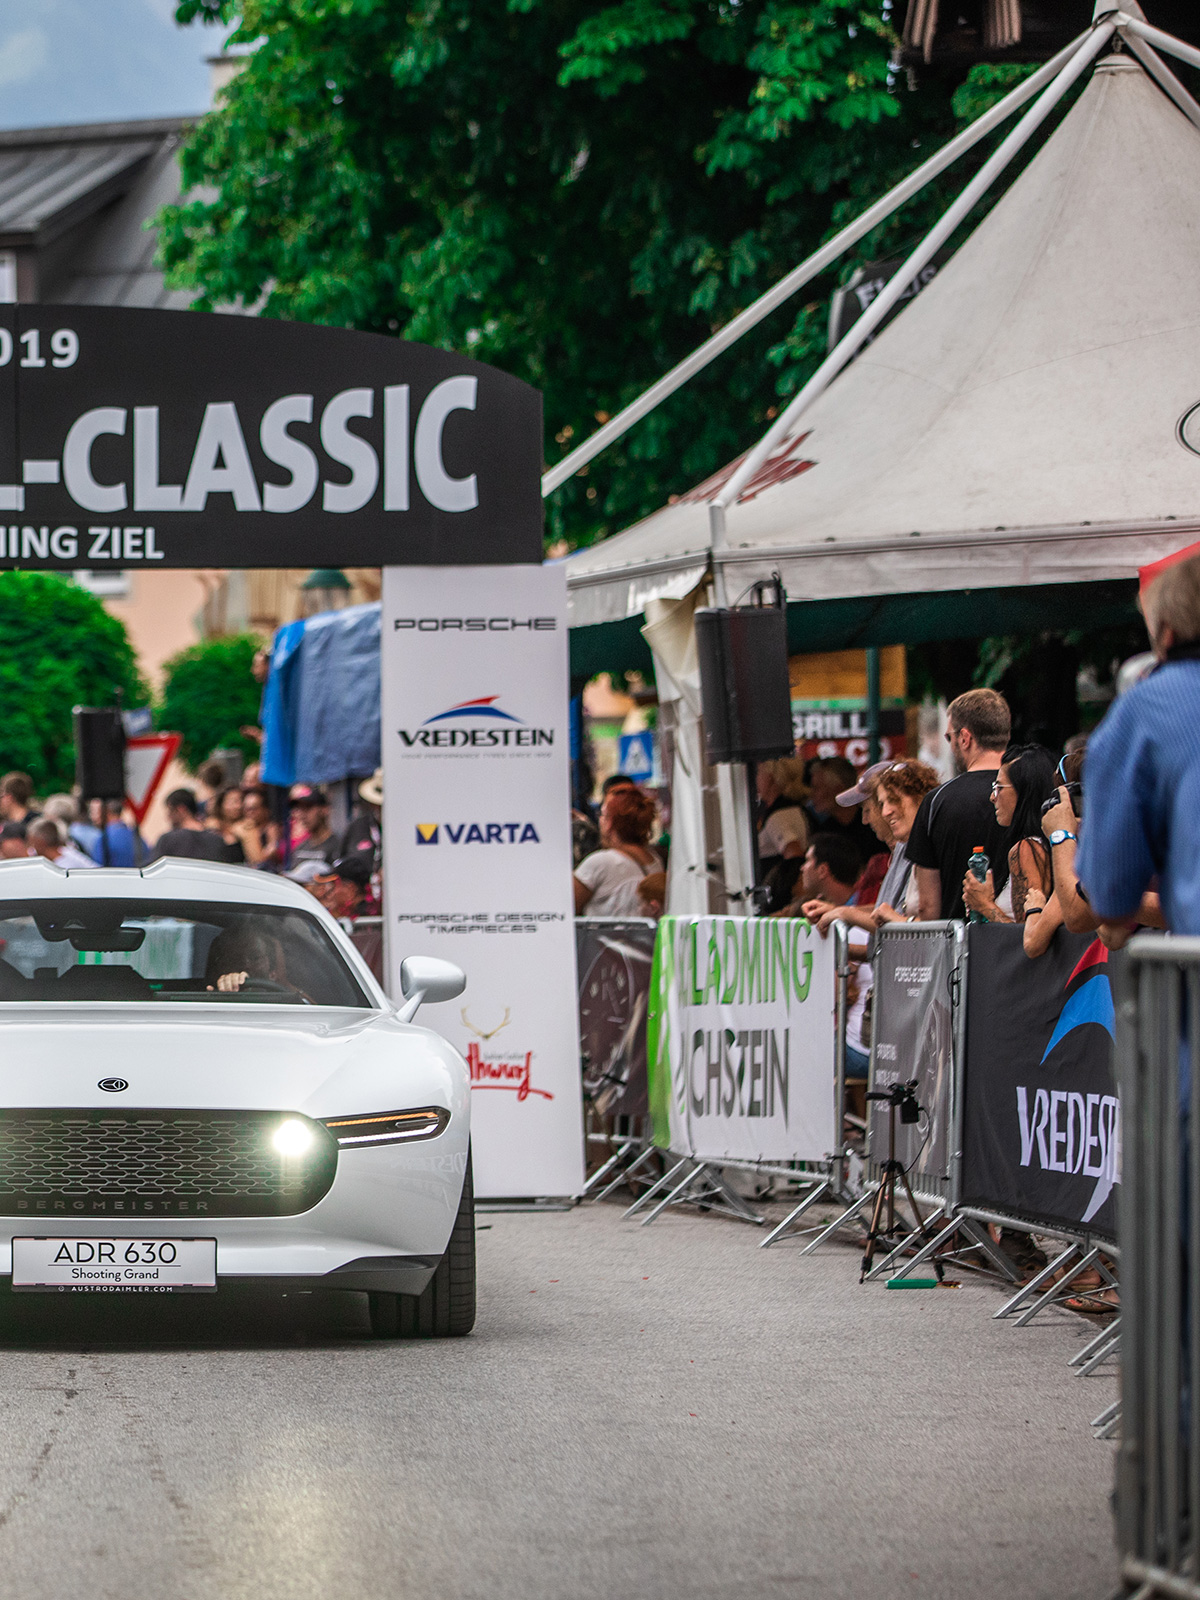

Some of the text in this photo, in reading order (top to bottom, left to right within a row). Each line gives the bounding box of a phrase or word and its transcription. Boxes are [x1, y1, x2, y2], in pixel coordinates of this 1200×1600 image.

[87, 526, 164, 560] ZIEL
[393, 617, 557, 632] PORSCHE
[397, 728, 555, 747] VREDESTEIN
[444, 823, 541, 844] VARTA
[397, 913, 566, 923] PORSCHE DESIGN
[426, 924, 538, 934] TIMEPIECES
[679, 917, 814, 1019] LADMING
[16, 1199, 209, 1211] BERGMEISTER
[53, 1242, 177, 1264] ADR 630
[71, 1267, 159, 1283] Shooting Grand
